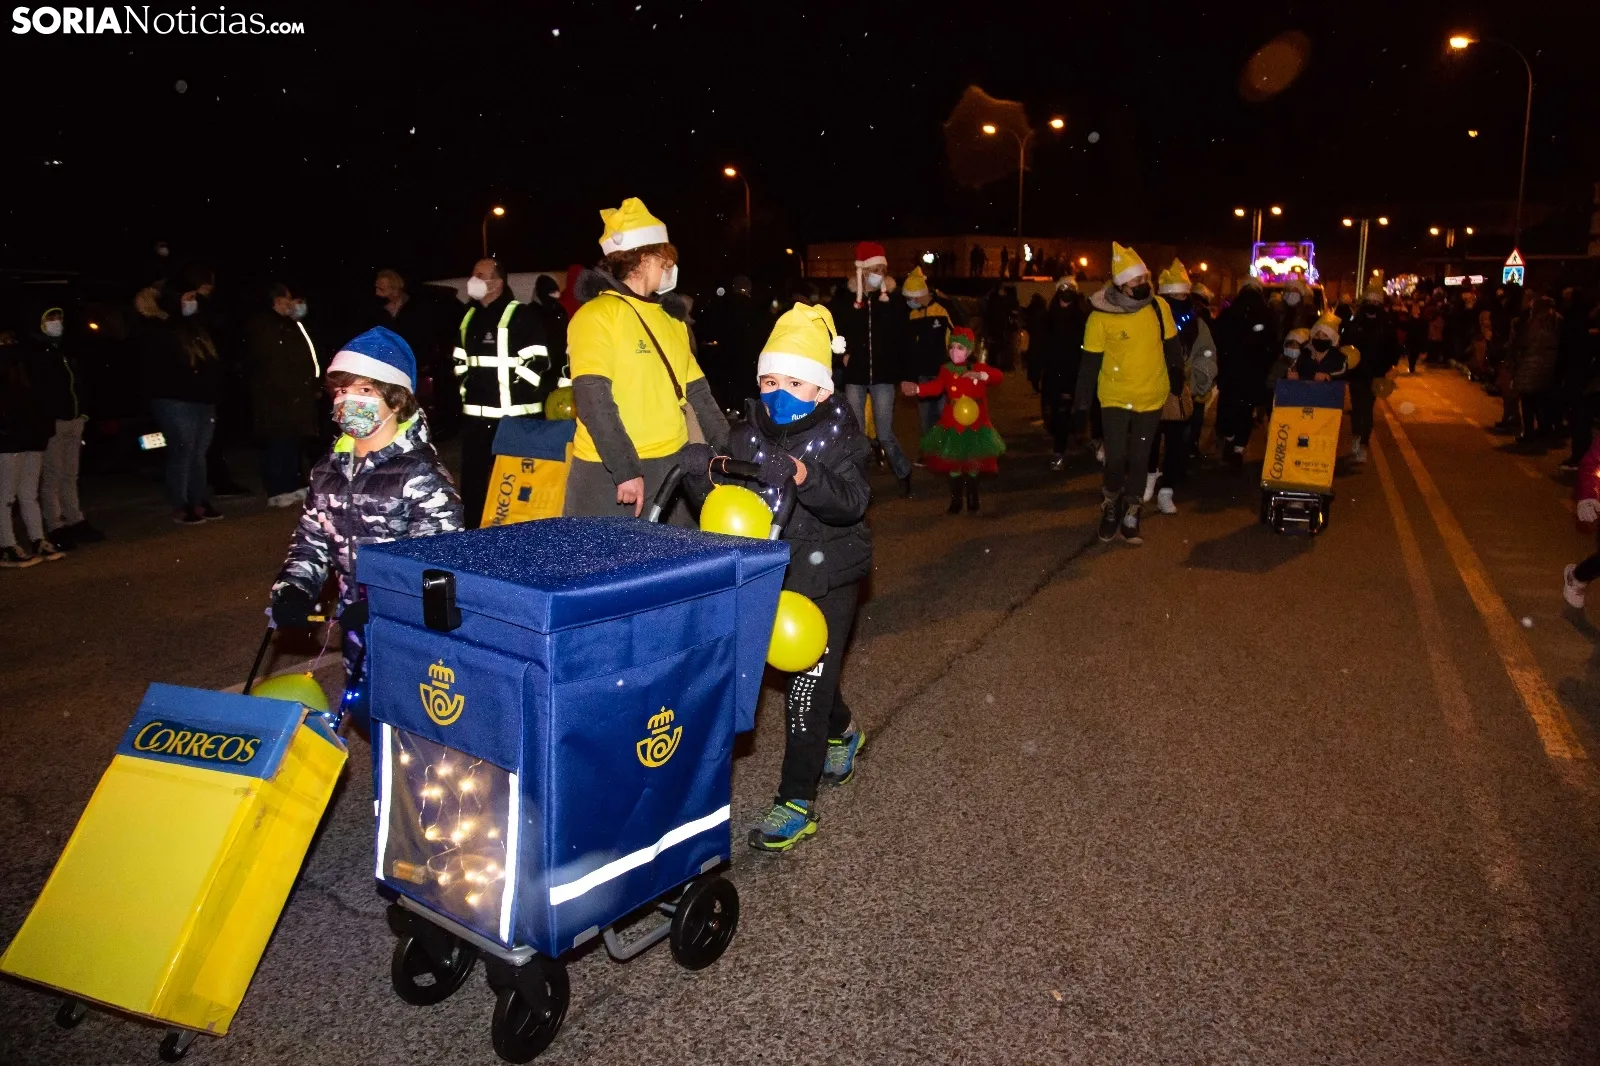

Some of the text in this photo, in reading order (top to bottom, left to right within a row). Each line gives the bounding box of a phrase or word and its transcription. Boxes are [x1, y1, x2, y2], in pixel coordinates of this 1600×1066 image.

[1269, 423, 1291, 480] CORREOS
[492, 472, 517, 527] RREOS
[133, 721, 261, 763] CORREOS
